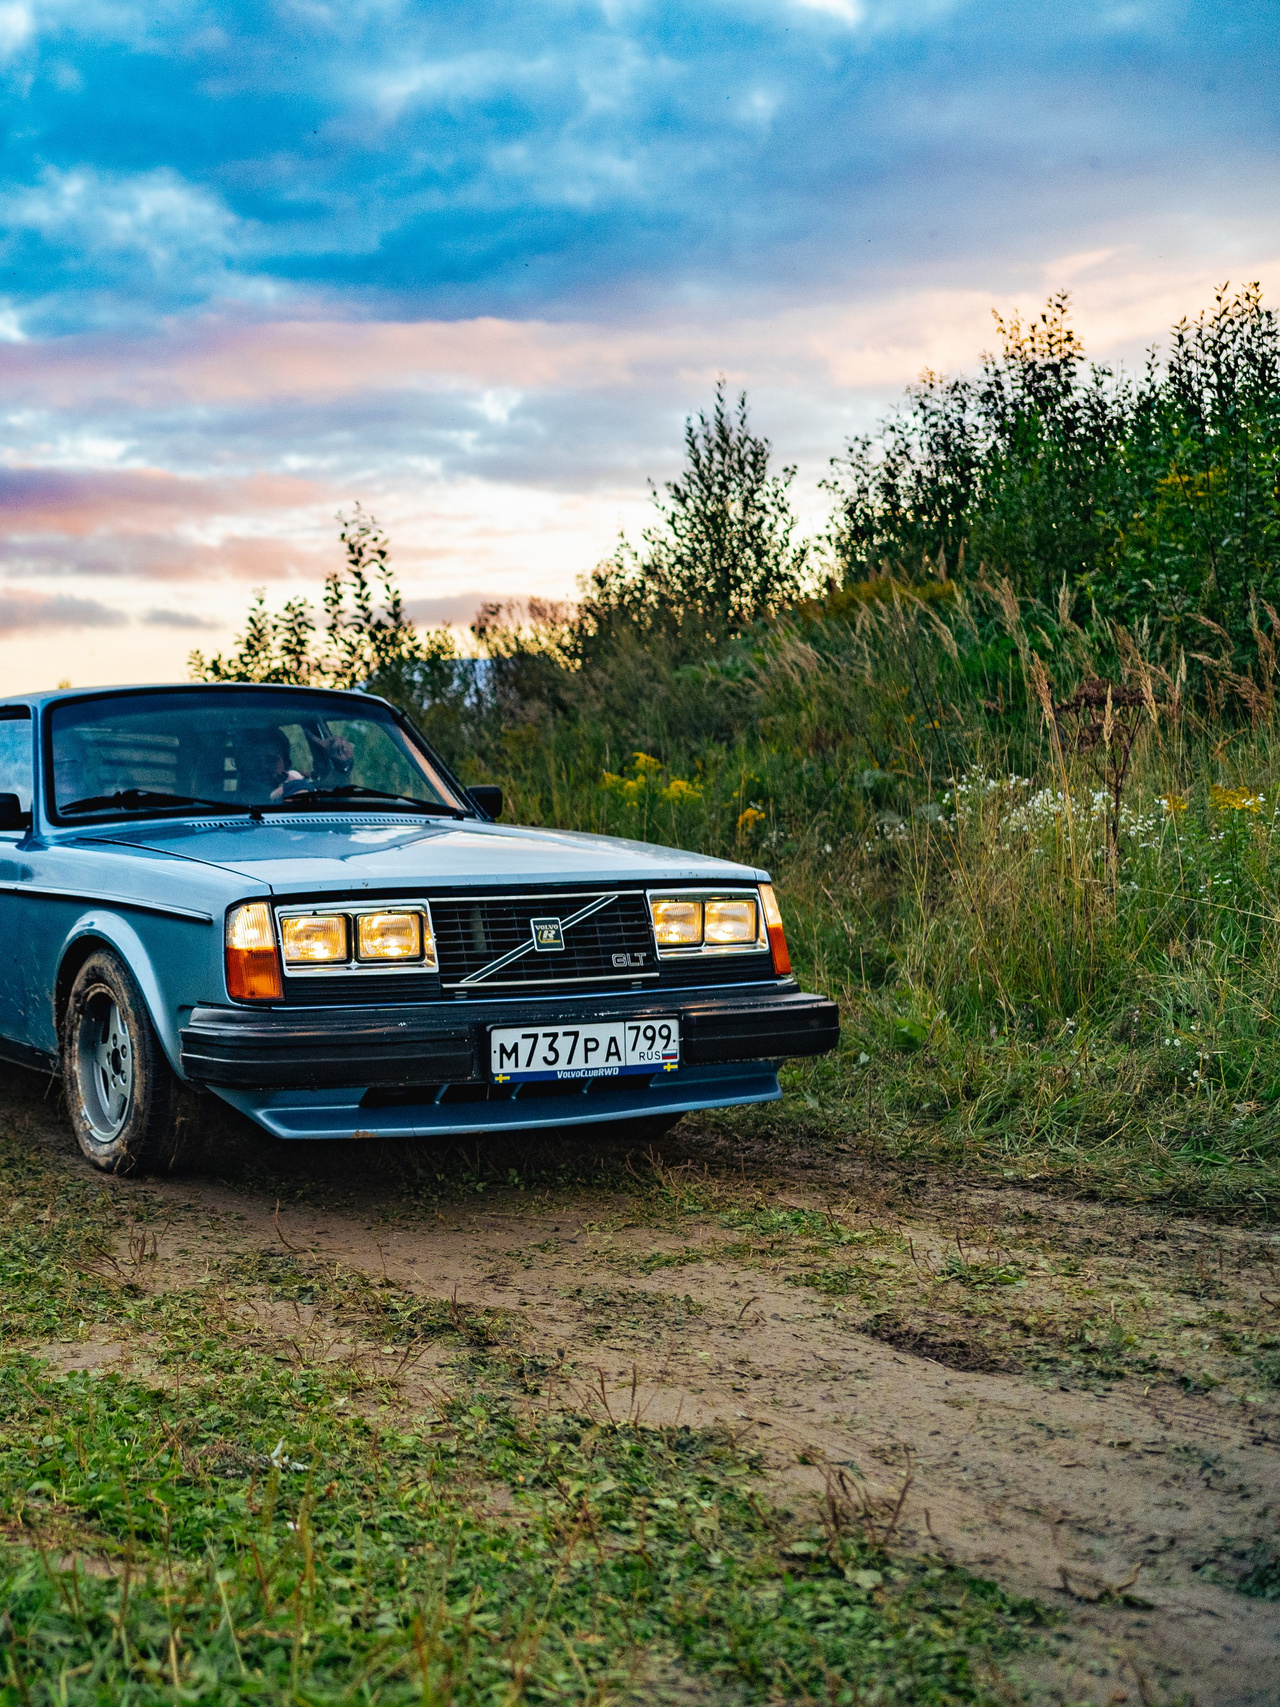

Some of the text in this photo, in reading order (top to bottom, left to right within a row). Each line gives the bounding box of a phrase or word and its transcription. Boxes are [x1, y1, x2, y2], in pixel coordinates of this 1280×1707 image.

[612, 953, 646, 967] GLT
[628, 1024, 671, 1051] 799
[639, 1051, 661, 1061] RUS
